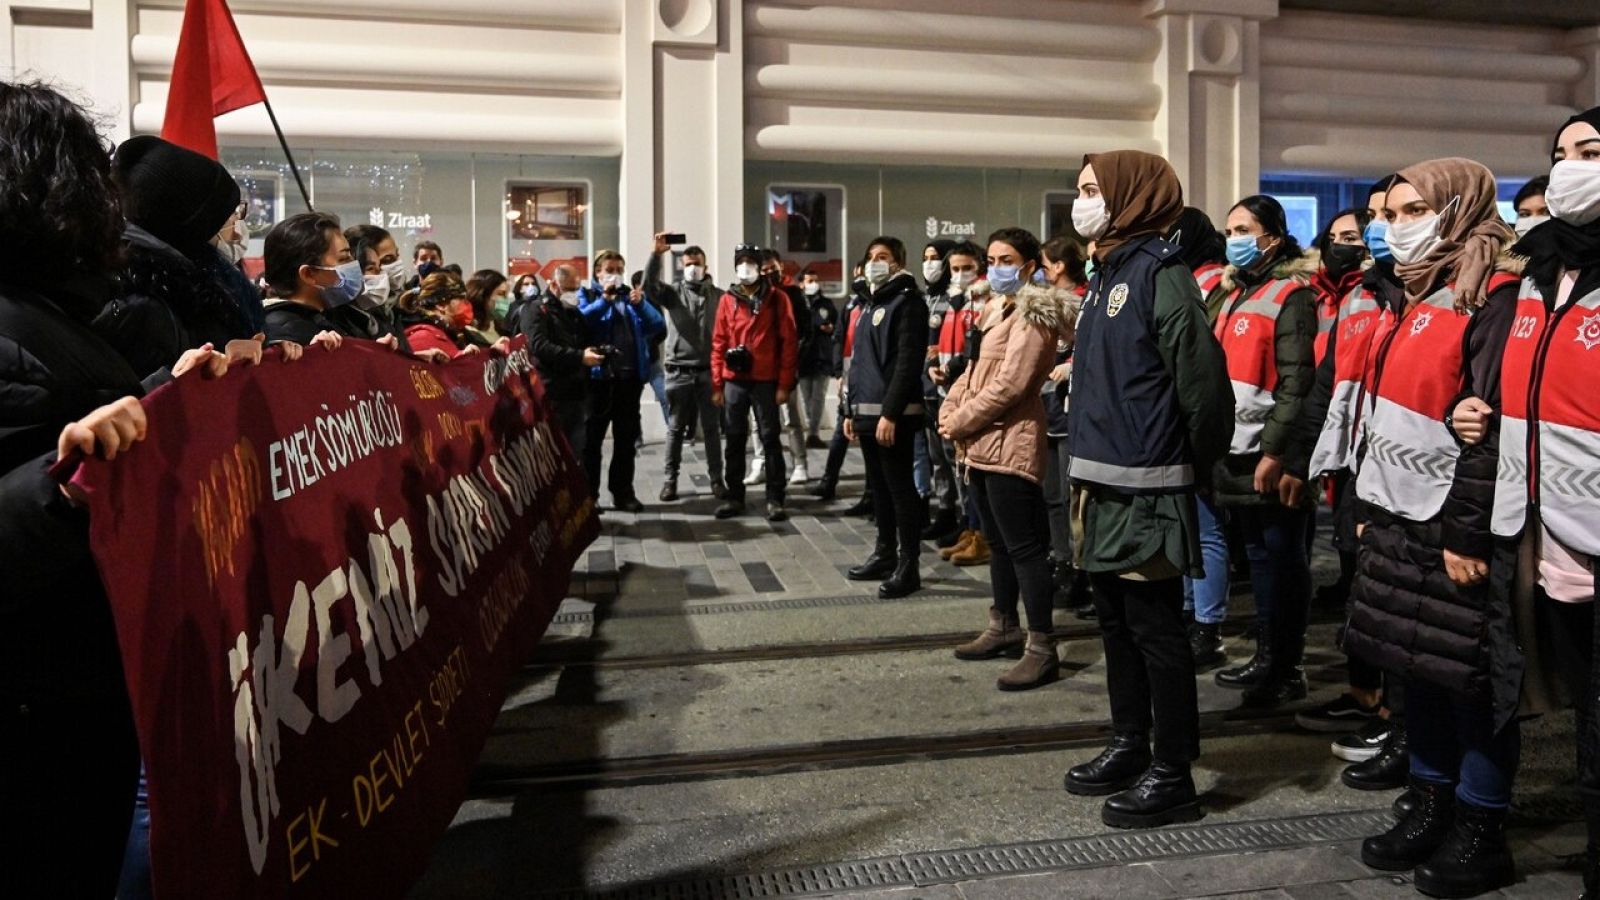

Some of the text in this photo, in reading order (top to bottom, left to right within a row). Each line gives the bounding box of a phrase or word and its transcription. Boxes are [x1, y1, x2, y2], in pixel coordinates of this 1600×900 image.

[388, 212, 432, 228] Ziraat
[940, 220, 976, 236] Ziraat
[269, 424, 326, 501] EMEK
[351, 699, 431, 830] DEVLET
